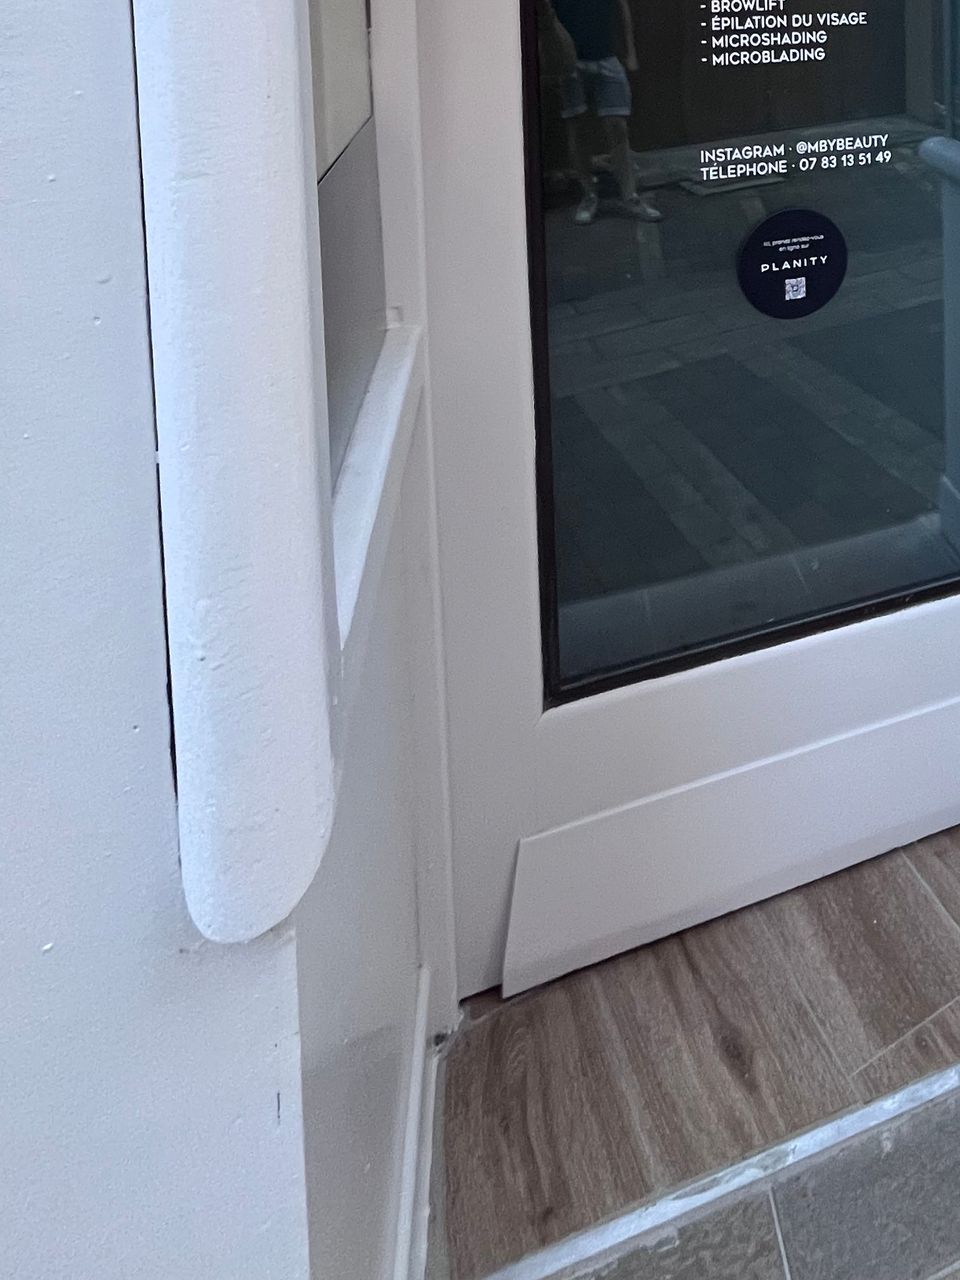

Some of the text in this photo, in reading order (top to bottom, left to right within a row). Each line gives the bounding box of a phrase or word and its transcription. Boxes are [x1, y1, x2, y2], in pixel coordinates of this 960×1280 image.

[712, 15, 787, 30] ÉPILATION
[792, 14, 812, 27] DU
[817, 12, 867, 25] VISAGE
[712, 30, 827, 48] MICROSHADING
[712, 48, 825, 66] MICROBLADING
[701, 144, 784, 162] INSTAGRAM
[796, 134, 888, 154] @MBYBEAUTY
[700, 160, 787, 180] TÉLEPHONE
[799, 157, 817, 171] 07
[821, 156, 836, 168] 83
[841, 154, 854, 166] 13
[859, 153, 871, 165] 51
[875, 151, 891, 163] 49
[761, 255, 827, 272] PLANITY
